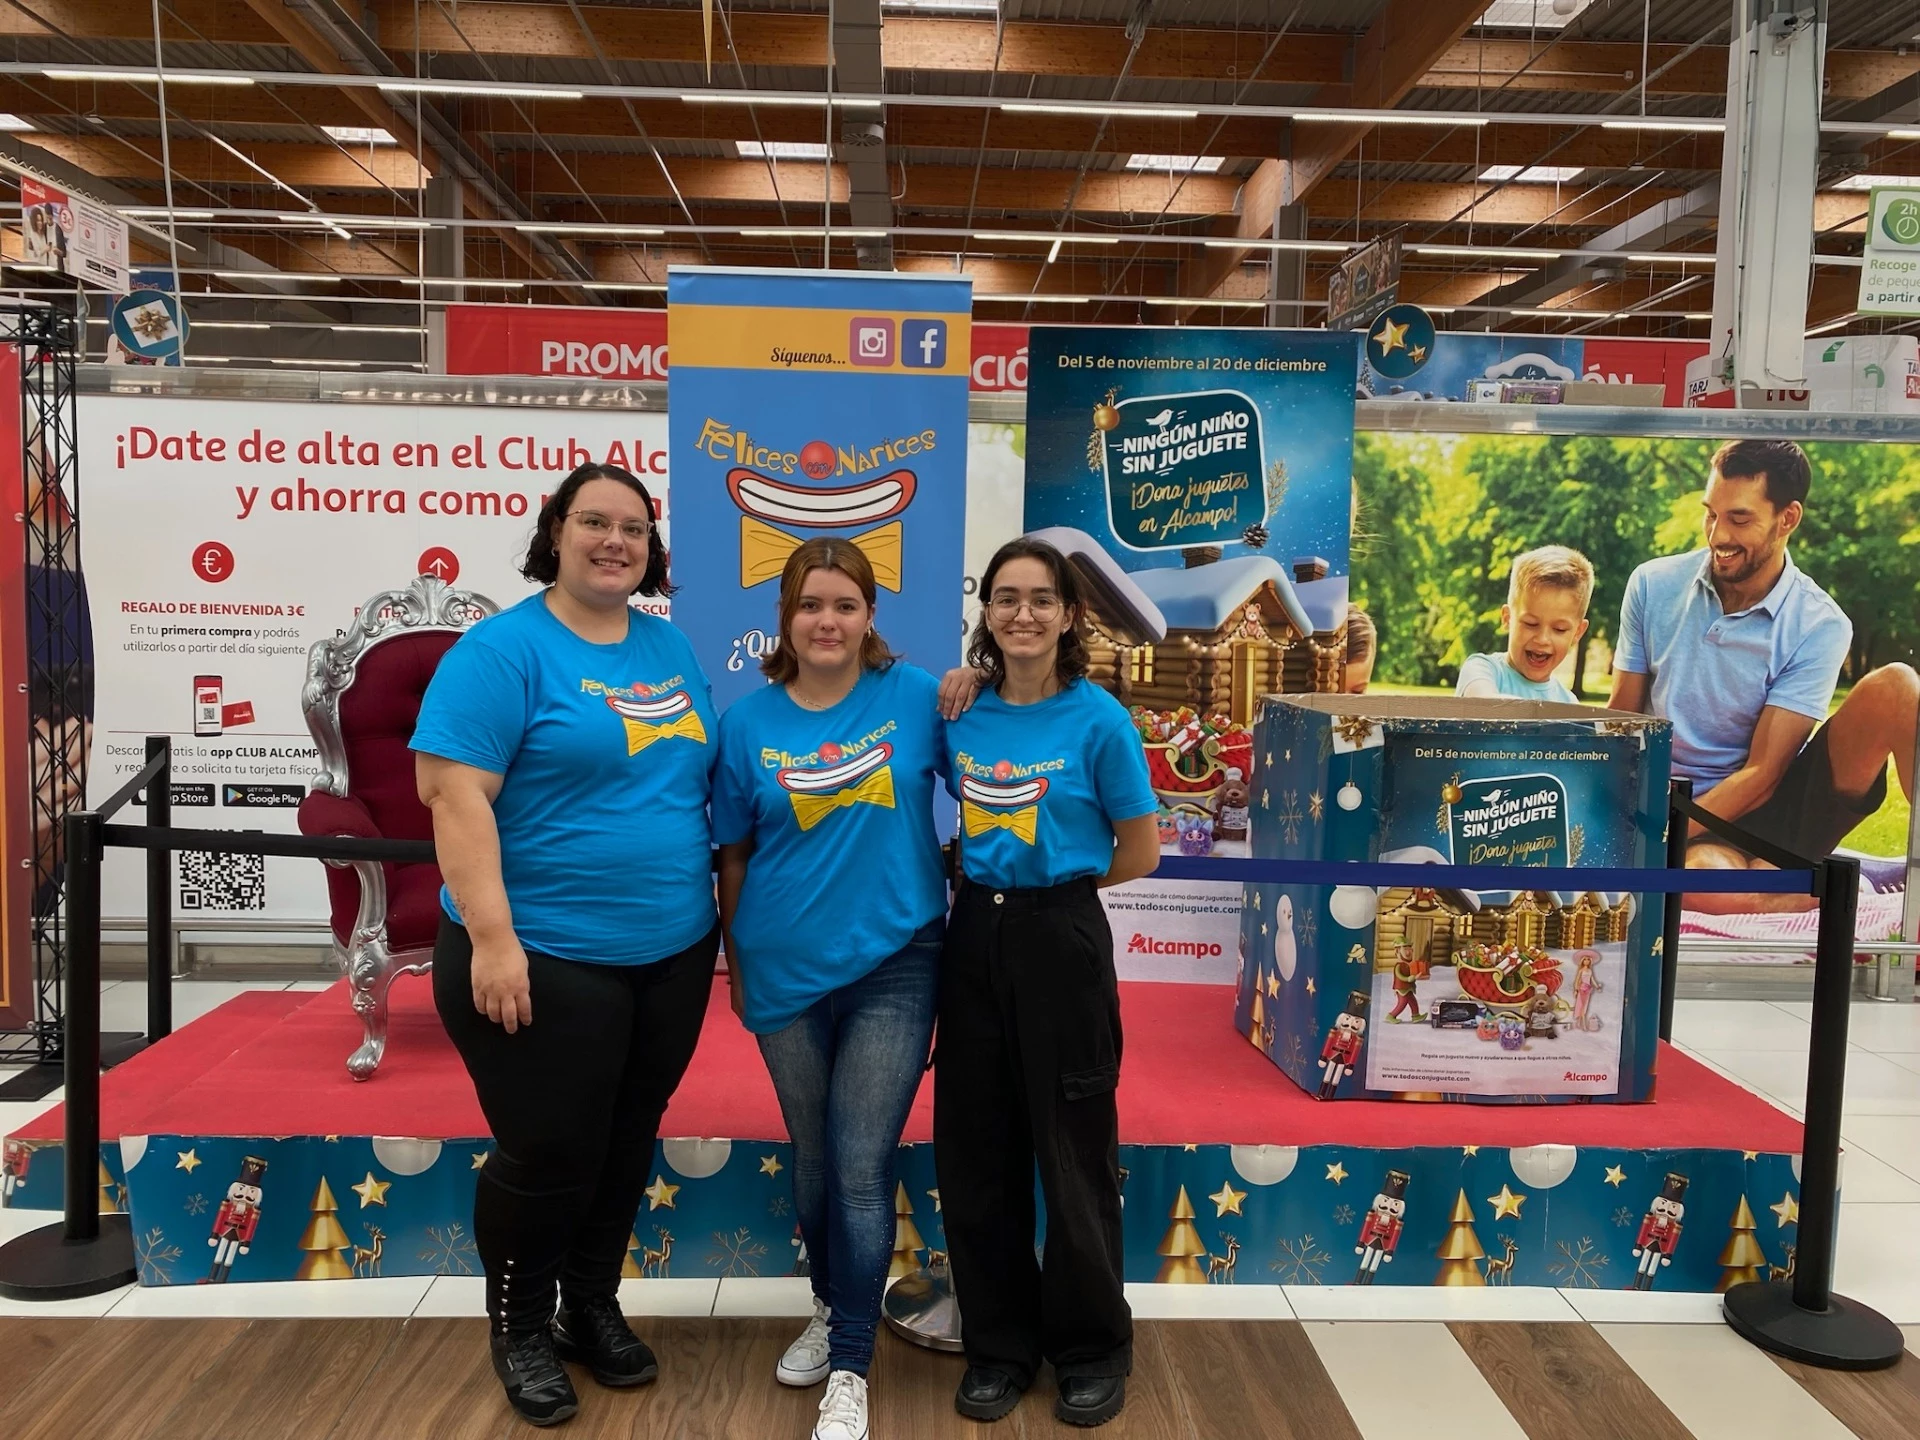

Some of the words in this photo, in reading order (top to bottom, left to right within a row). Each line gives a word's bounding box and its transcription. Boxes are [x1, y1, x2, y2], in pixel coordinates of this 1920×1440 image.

[1900, 203, 1917, 215] 2h
[1870, 259, 1917, 272] Recoge
[1868, 274, 1884, 286] de
[1887, 276, 1920, 289] peque
[1866, 293, 1874, 302] a
[1878, 292, 1914, 304] partir
[770, 347, 846, 366] Síguenos...
[1058, 355, 1082, 370] Del
[1085, 356, 1094, 370] 5
[1097, 356, 1114, 370] de
[1117, 357, 1194, 372] noviembre
[1197, 357, 1210, 371] al
[1213, 358, 1232, 371] 20
[1233, 358, 1252, 372] de
[1254, 358, 1326, 372] diciembre
[972, 346, 1028, 388] CIÓ
[1122, 422, 1196, 454] NINGÚN
[1201, 409, 1250, 439] NIÑO
[116, 426, 226, 469] ¡Date
[238, 429, 286, 464] de
[298, 430, 380, 466] alta
[392, 442, 438, 468] en
[451, 435, 487, 469] el
[498, 436, 592, 472] Club
[834, 428, 937, 477] Narices
[1121, 454, 1156, 474] SIN
[1158, 431, 1247, 470] JUGUETE
[1186, 472, 1249, 502] juguetes
[236, 486, 260, 520] y
[270, 477, 406, 514] ahorra
[418, 489, 528, 517] como
[1138, 518, 1158, 534] en
[1160, 494, 1238, 540] Alcampo!
[121, 602, 176, 614] REGALO
[180, 602, 196, 614] DE
[200, 604, 284, 616] BIENVENIDA
[286, 606, 305, 616] 3€
[634, 604, 672, 616] SCU
[130, 624, 144, 634] En
[147, 626, 158, 634] tu
[161, 625, 206, 637] primera
[208, 628, 252, 638] compra
[254, 630, 260, 639] y
[262, 627, 300, 638] podrás
[123, 641, 176, 653] utilizarlos
[178, 644, 184, 653] a
[188, 643, 218, 656] partir
[220, 642, 236, 654] del
[238, 642, 256, 654] día
[258, 644, 307, 656] siguiente.
[840, 720, 897, 761] Narices
[106, 744, 145, 756] Descar
[171, 747, 194, 756] atis
[196, 746, 207, 756] la
[210, 750, 233, 760] app
[236, 748, 267, 758] CLUB
[270, 748, 320, 758] ALCAMP
[1415, 748, 1434, 758] Del
[1436, 750, 1442, 758] 5
[1446, 749, 1458, 759] de
[1460, 750, 1516, 760] noviembre
[1518, 750, 1528, 760] al
[1530, 751, 1542, 760] 20
[1544, 750, 1558, 760] de
[1559, 750, 1610, 761] diciembre
[114, 765, 122, 774] y
[182, 766, 188, 774] o
[192, 764, 232, 774] solicita
[234, 765, 246, 774] tu
[250, 765, 286, 777] tarjeta
[1012, 758, 1064, 779] Narices
[180, 793, 208, 802] Store
[246, 795, 280, 806] Google
[282, 796, 301, 806] Play
[1464, 798, 1520, 822] NINGÚN
[1522, 789, 1558, 808] NIÑO
[1462, 822, 1488, 838] SIN
[1490, 806, 1556, 836] JUGUETE
[1508, 836, 1557, 864] juguetes
[1108, 902, 1241, 914] www.todosconjuguete.com
[1128, 933, 1222, 960] Alcampo
[1382, 1073, 1470, 1082] www.todosconjuguete.com
[1563, 1071, 1608, 1082] Alcampo
